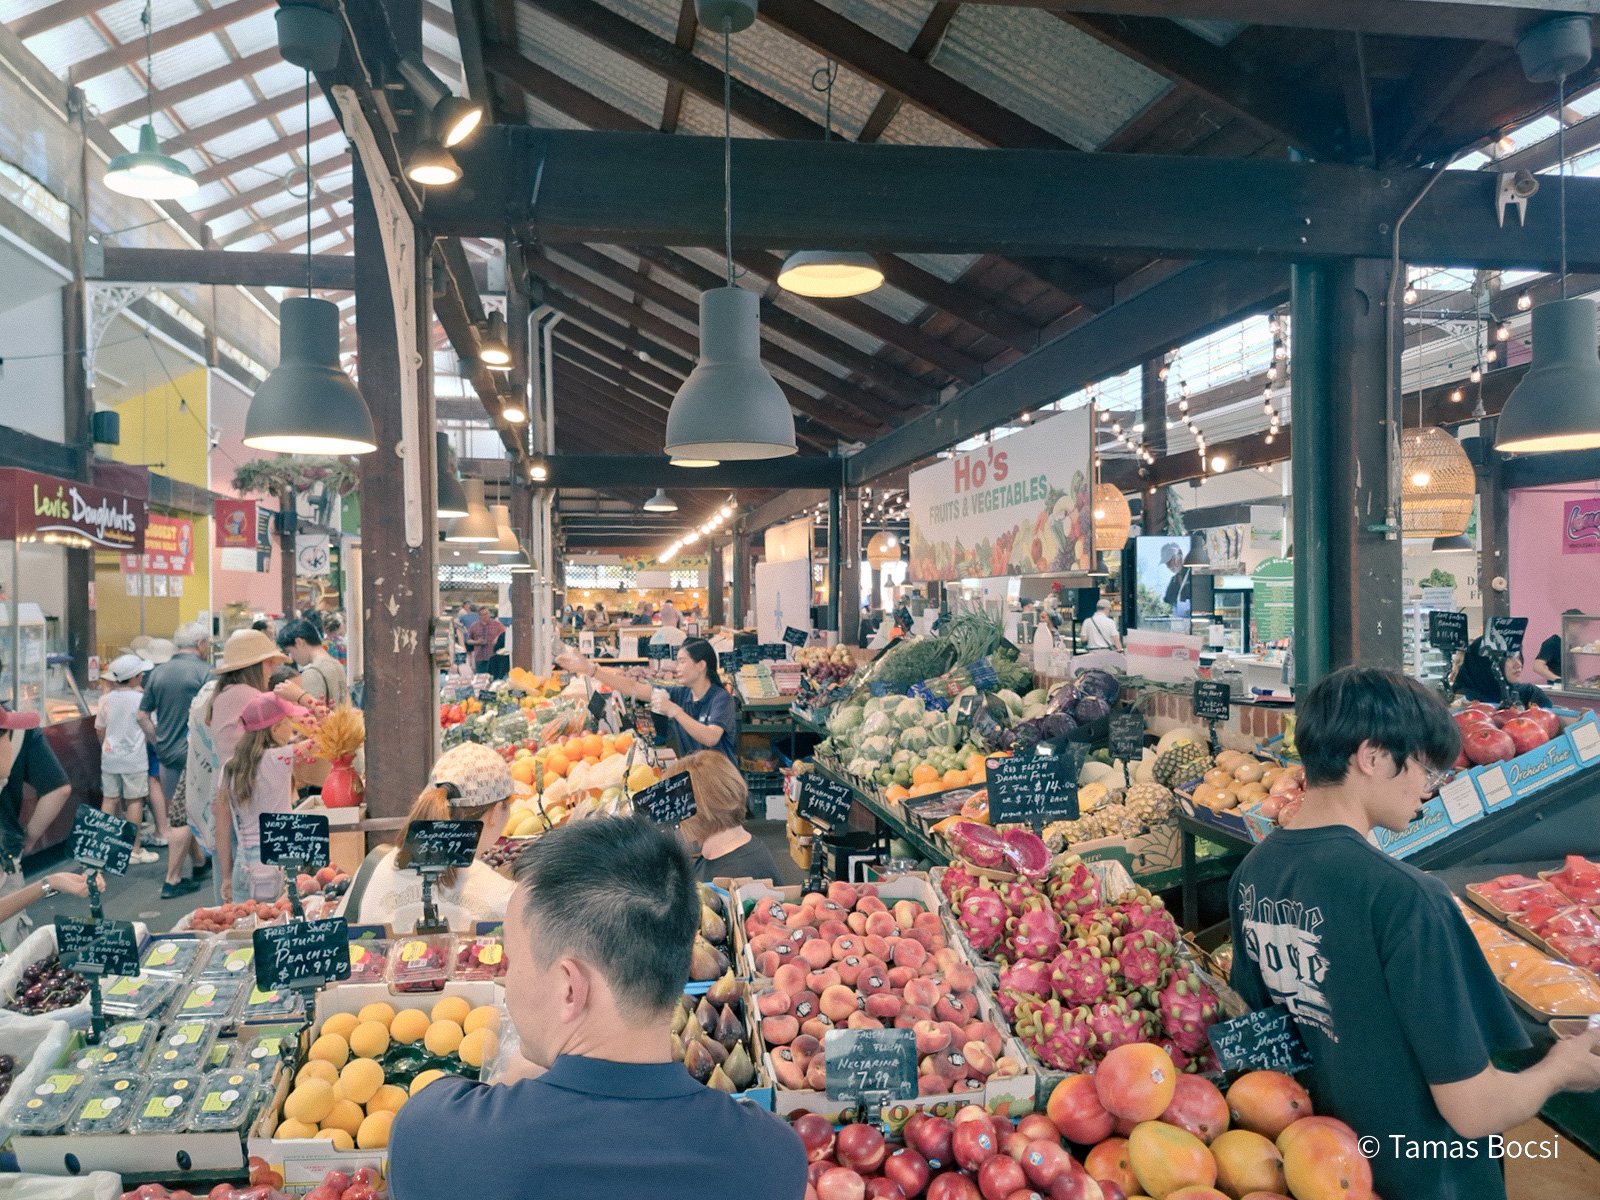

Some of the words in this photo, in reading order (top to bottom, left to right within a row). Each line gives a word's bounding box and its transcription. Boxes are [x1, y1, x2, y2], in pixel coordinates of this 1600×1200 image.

[954, 447, 1009, 494] Ho's
[929, 500, 960, 525] FRUITS
[962, 504, 969, 517] &
[972, 474, 1048, 514] VEGETABLES
[69, 486, 136, 540] Doughnuts
[1021, 762, 1049, 773] FLESH
[1509, 756, 1548, 785] Orchard
[1547, 745, 1570, 767] Fruit
[1000, 785, 1007, 794] 2
[90, 808, 105, 820] THE
[264, 821, 287, 830] VERY
[291, 821, 320, 834] SWEET
[1380, 819, 1420, 848] Orchard
[273, 842, 283, 852] 2
[416, 840, 462, 855] $5.99
[264, 923, 299, 940] FRESH
[306, 920, 344, 934] SWEET
[272, 933, 325, 951] TATURA
[1216, 1031, 1243, 1049] VERY
[1252, 1014, 1291, 1037] SWEET
[1224, 1011, 1266, 1033] JUMBO
[837, 1058, 900, 1070] NECTARINE
[847, 1071, 890, 1089] $7.99
[838, 1099, 971, 1124] COICE
